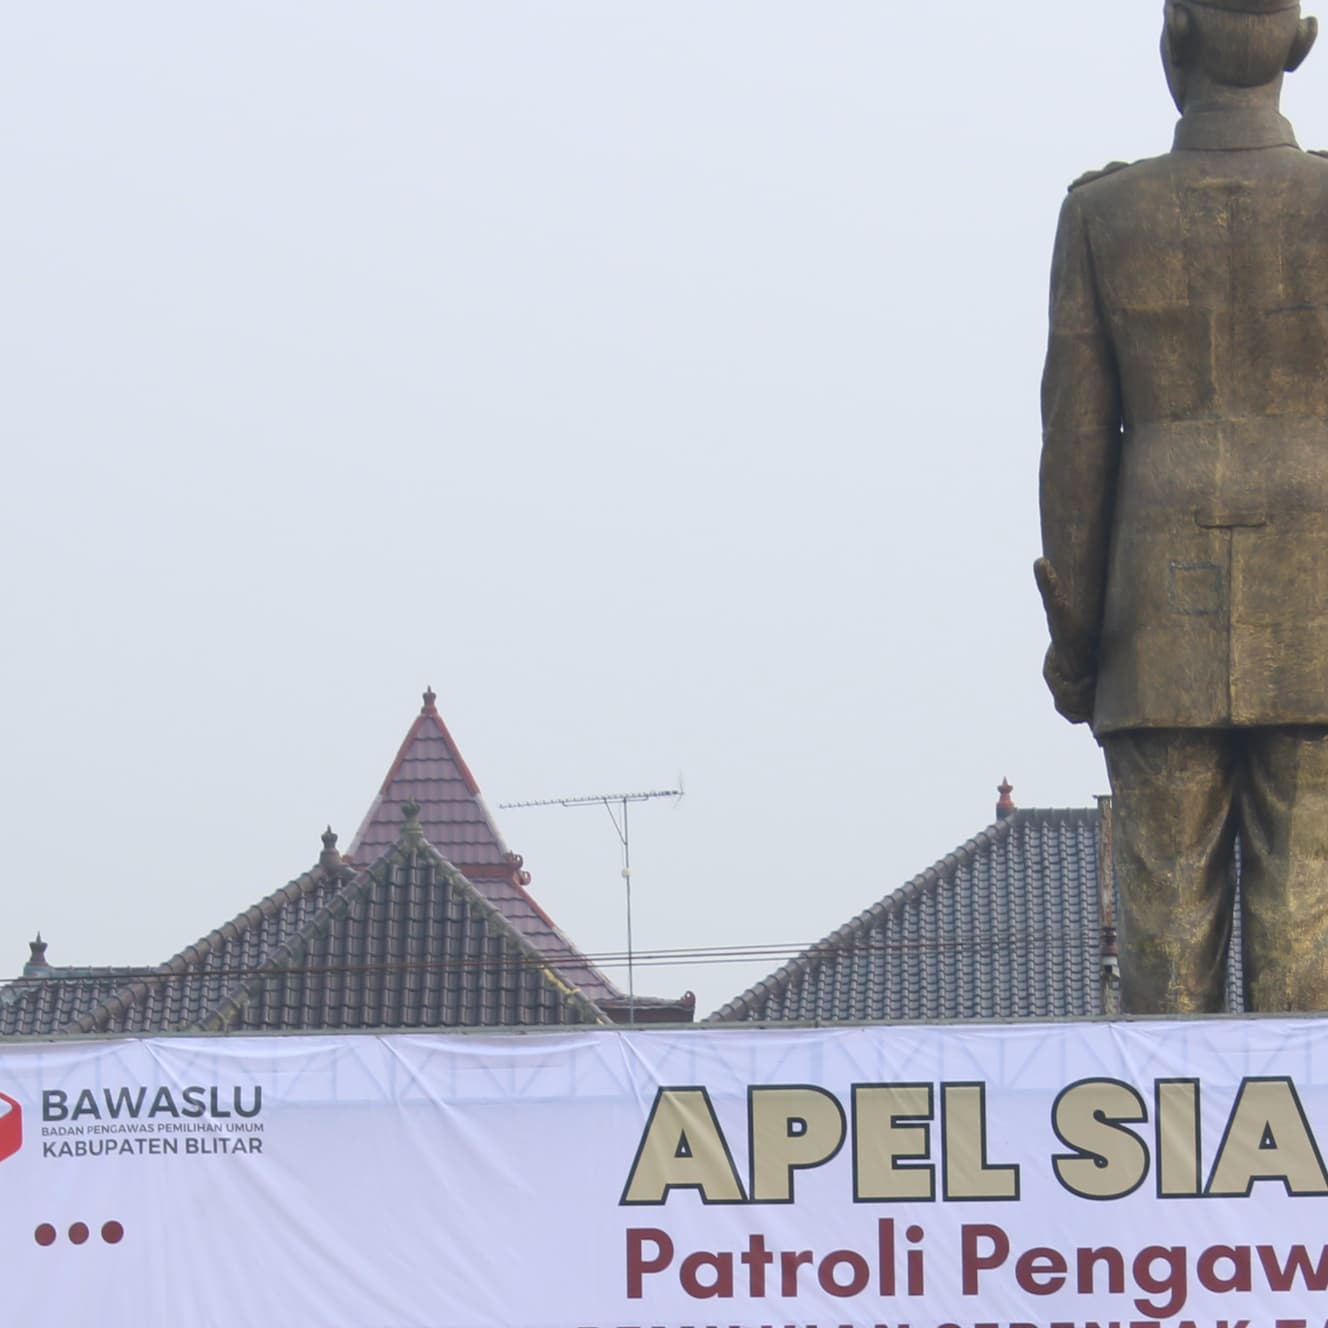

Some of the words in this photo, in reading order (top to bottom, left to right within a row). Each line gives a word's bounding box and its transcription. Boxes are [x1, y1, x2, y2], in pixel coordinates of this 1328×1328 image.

[41, 1085, 263, 1122] BAWASLU
[41, 1127, 84, 1136] BADAN
[87, 1123, 155, 1135] PENGAWAS
[157, 1122, 223, 1134] PEMILIHAN
[225, 1122, 264, 1133] UMUM
[43, 1138, 179, 1158] KABUPATEN
[185, 1137, 263, 1154] BLITAR
[618, 1081, 1021, 1206] APEL
[626, 1217, 925, 1299] Patroli
